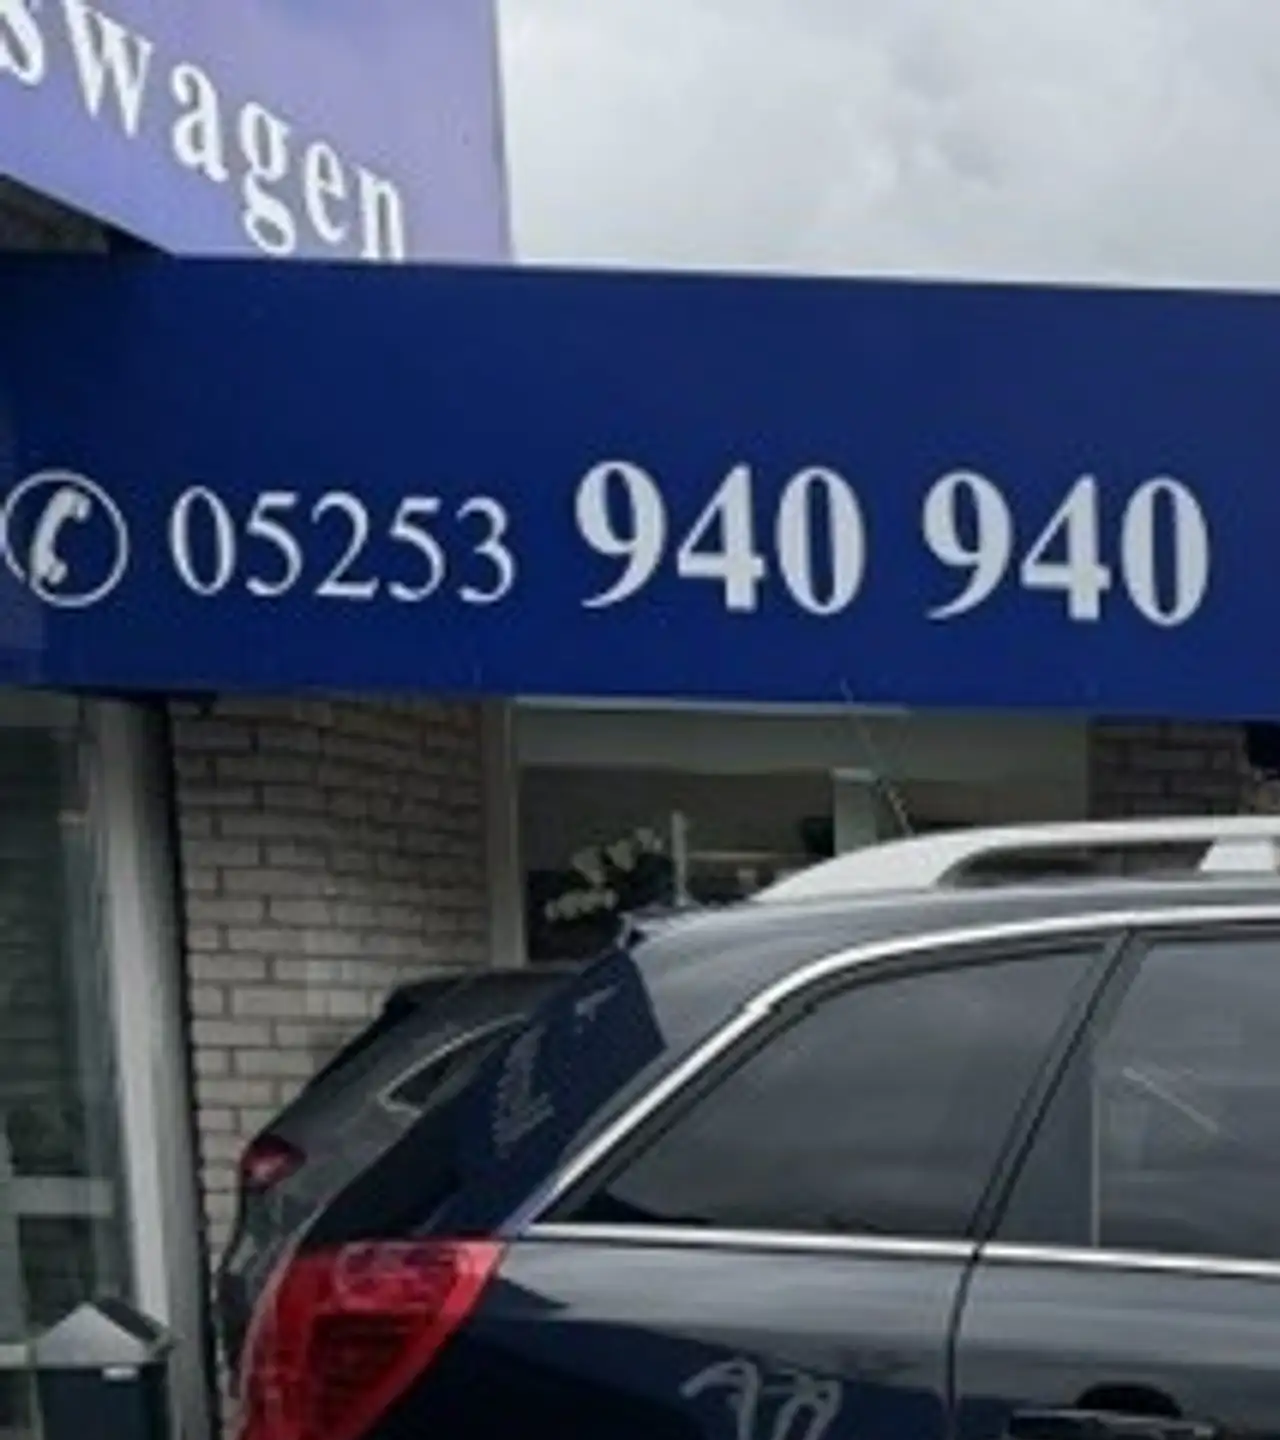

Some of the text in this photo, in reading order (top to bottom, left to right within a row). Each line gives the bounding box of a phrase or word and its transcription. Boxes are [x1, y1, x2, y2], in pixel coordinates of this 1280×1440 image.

[170, 461, 1209, 627] 05253 940 940
